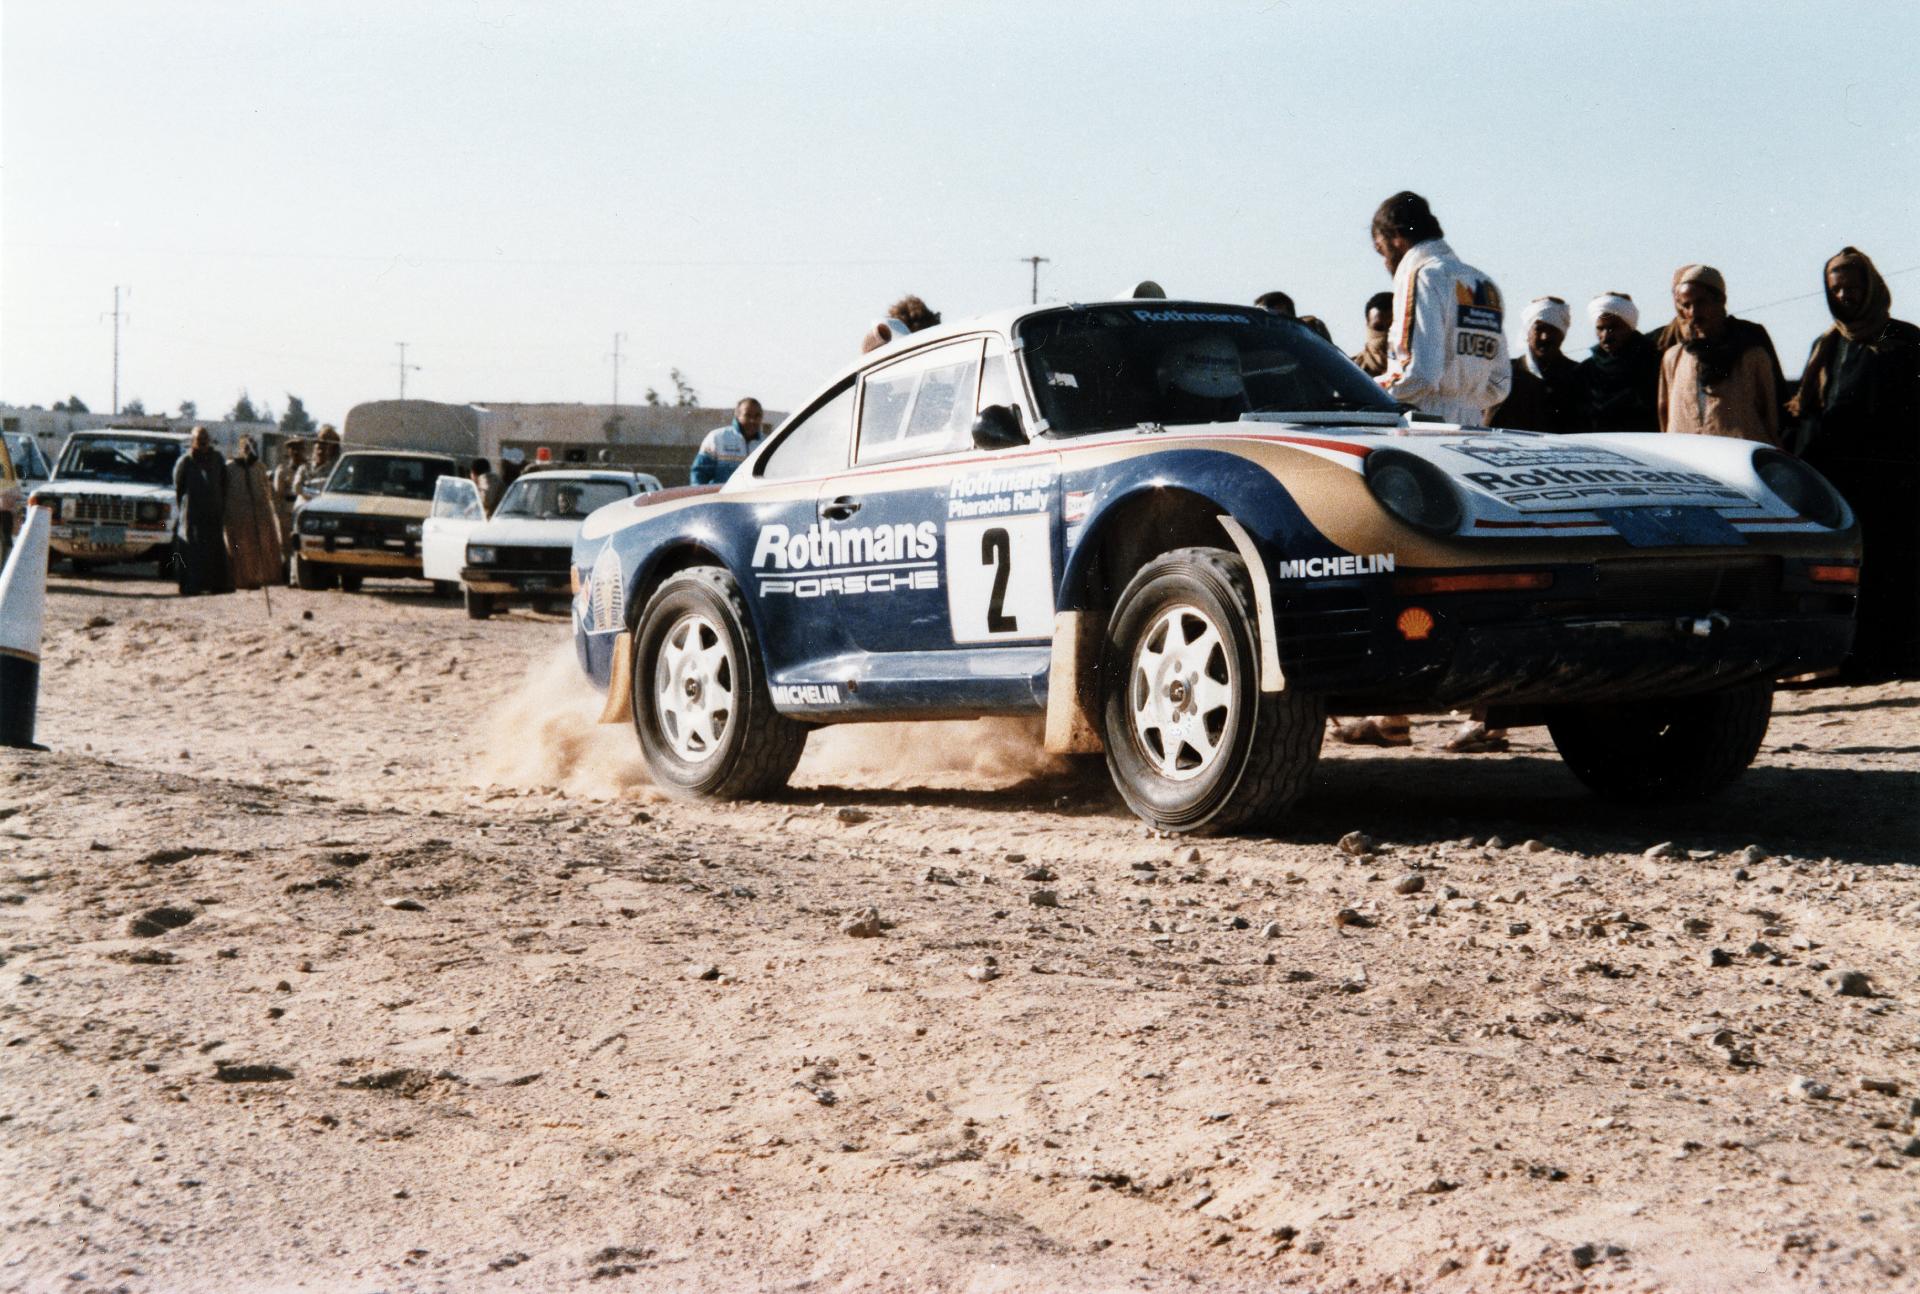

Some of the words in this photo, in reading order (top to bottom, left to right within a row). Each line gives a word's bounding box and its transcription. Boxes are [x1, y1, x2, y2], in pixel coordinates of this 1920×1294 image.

[1133, 309, 1250, 324] Rothmans
[950, 469, 1052, 498] Rothmans
[1463, 466, 1724, 491] Rothmans
[949, 496, 1011, 518] Pharaohs
[1013, 490, 1049, 512] Rally
[752, 520, 938, 569] Rothmans
[1279, 552, 1395, 579] MICHELIN
[760, 570, 939, 598] PORSCHE
[981, 527, 1019, 634] 2
[771, 684, 841, 704] MICHELIN
